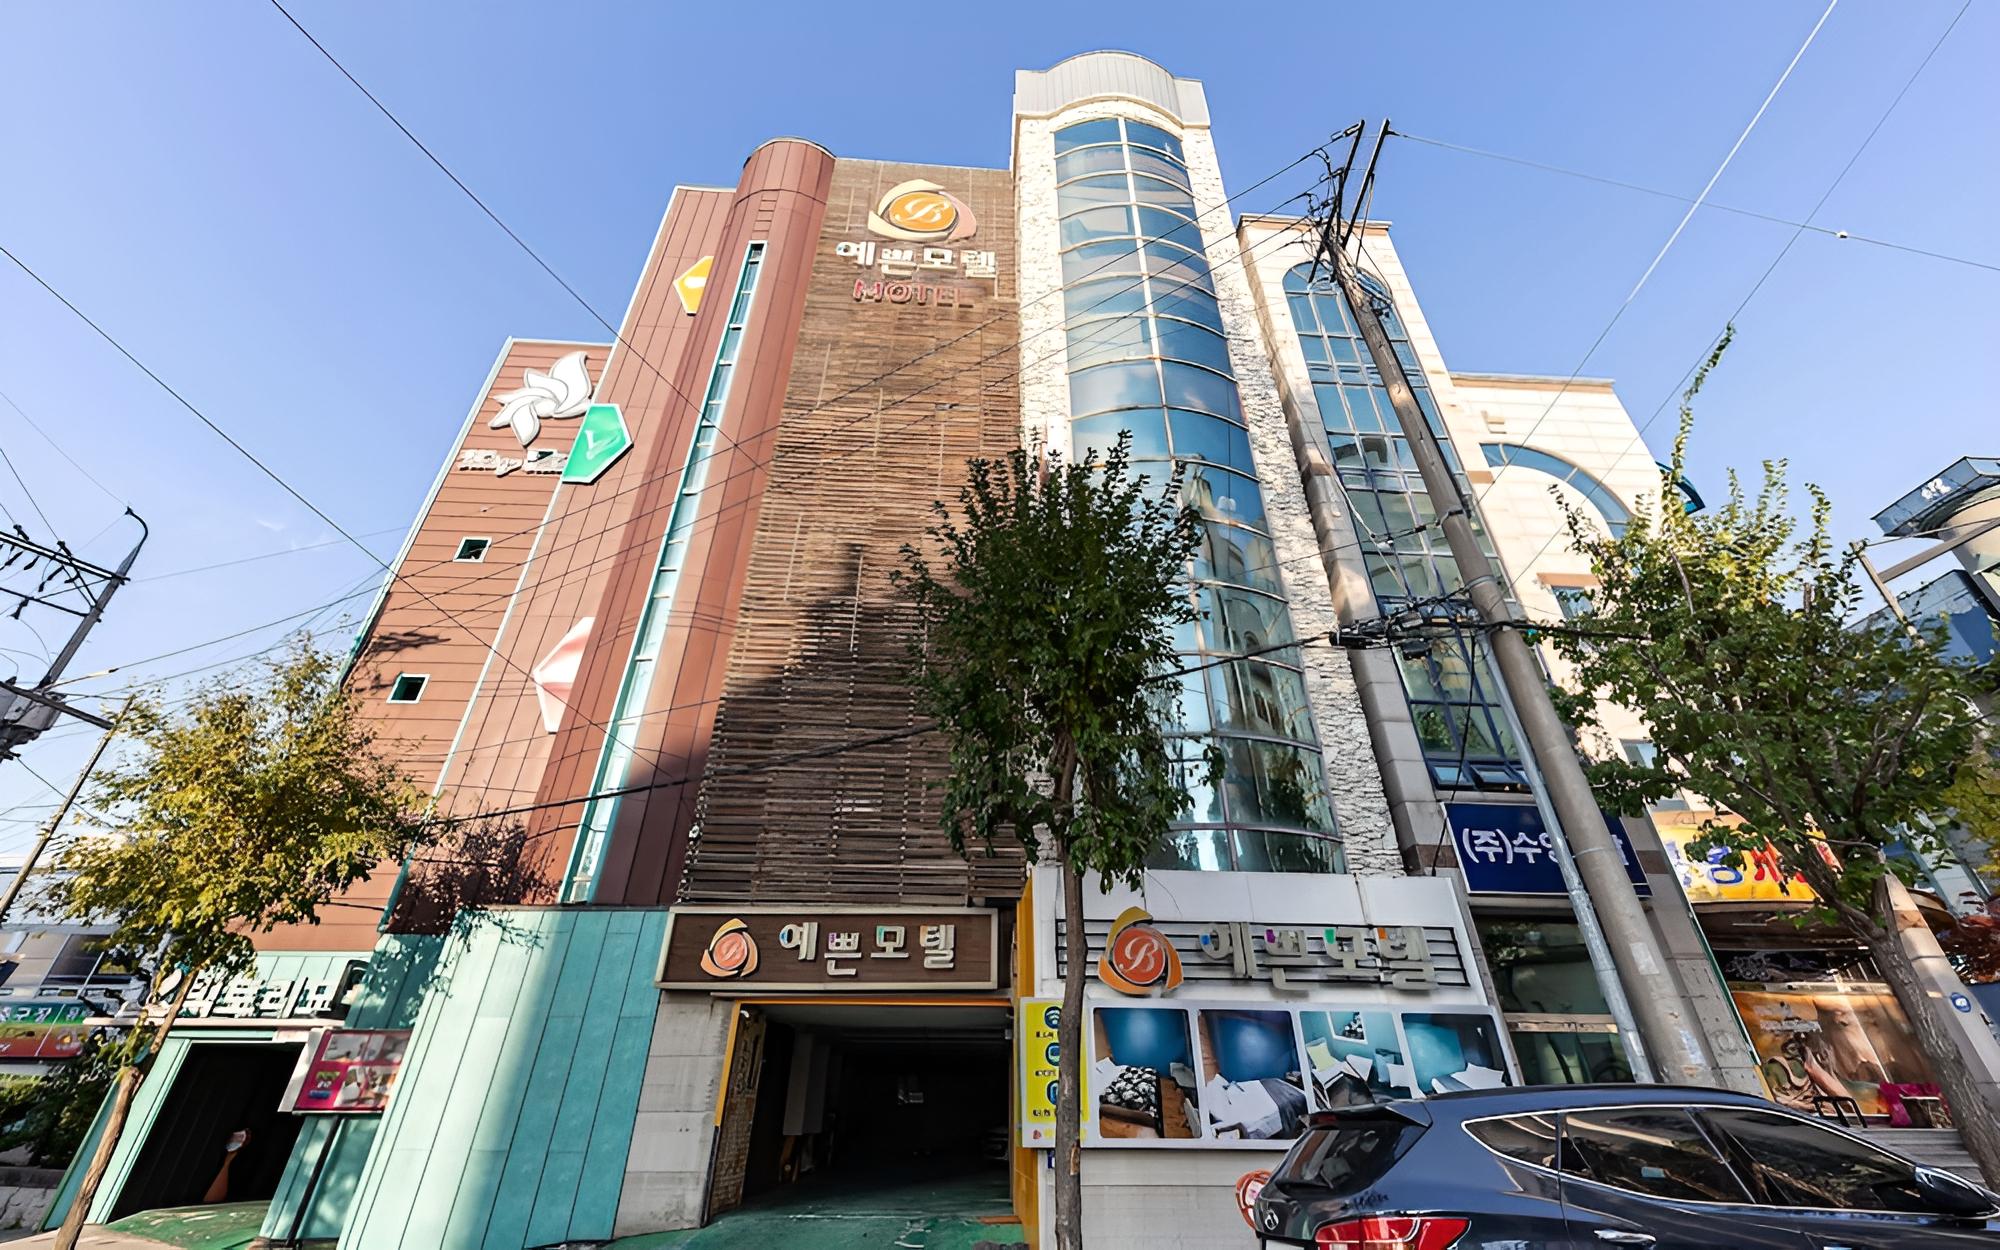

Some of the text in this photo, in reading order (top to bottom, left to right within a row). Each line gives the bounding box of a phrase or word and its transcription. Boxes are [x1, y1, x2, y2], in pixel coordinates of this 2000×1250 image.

[836, 241, 996, 279] 예쁜모텔
[853, 278, 974, 308] MOTEL
[778, 921, 956, 977] 예쁜모텔
[1199, 921, 1440, 991] 예쁜모텔
